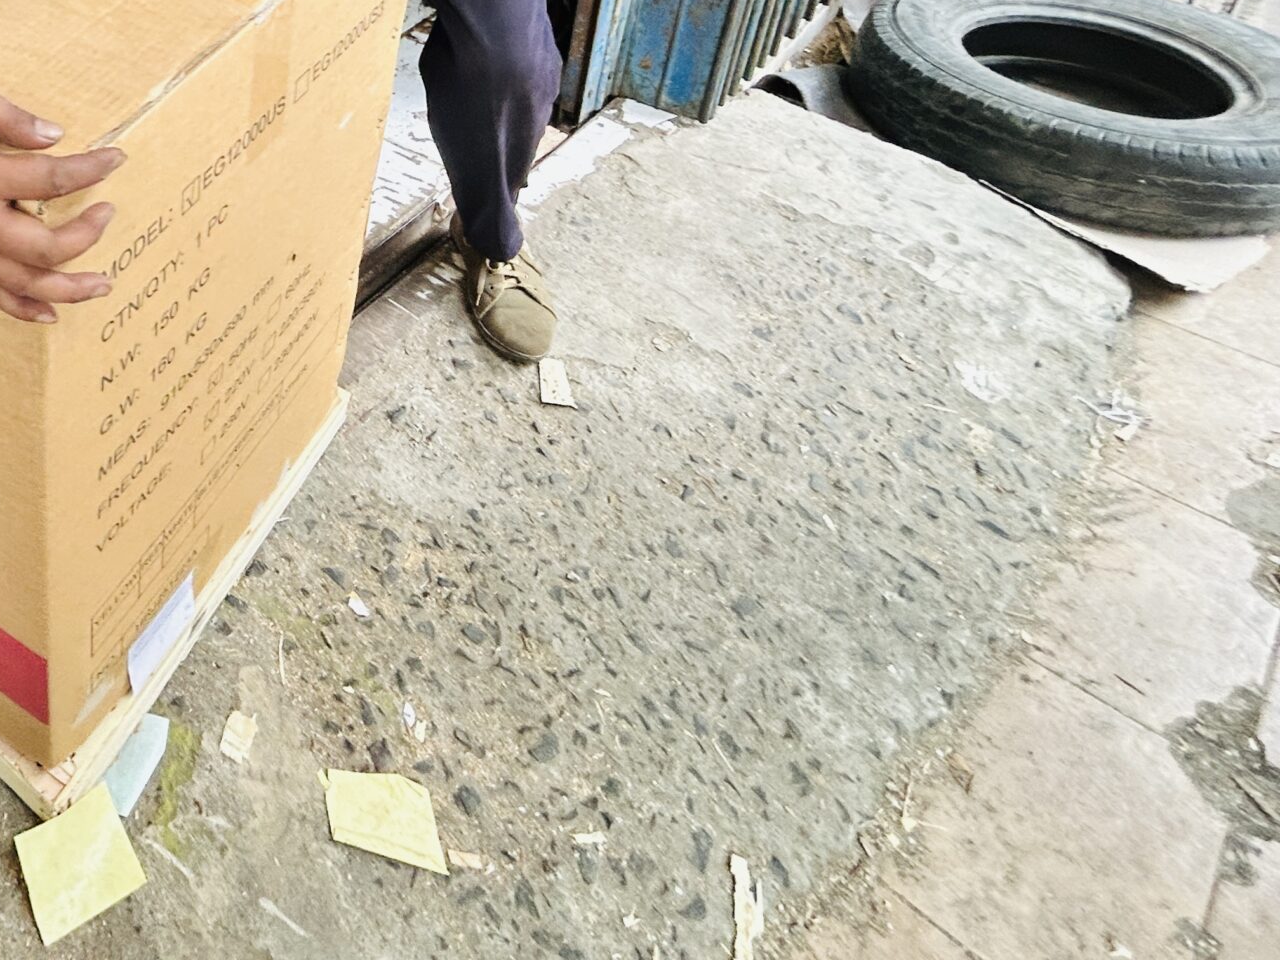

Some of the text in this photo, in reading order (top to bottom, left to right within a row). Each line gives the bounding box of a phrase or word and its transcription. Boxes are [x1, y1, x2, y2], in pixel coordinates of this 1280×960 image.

[201, 94, 287, 191] EG12000US
[206, 203, 230, 239] PC
[152, 300, 180, 338] 150
[187, 266, 211, 302] KG
[252, 276, 275, 306] mm
[150, 346, 177, 383] 160
[184, 311, 209, 345] KG
